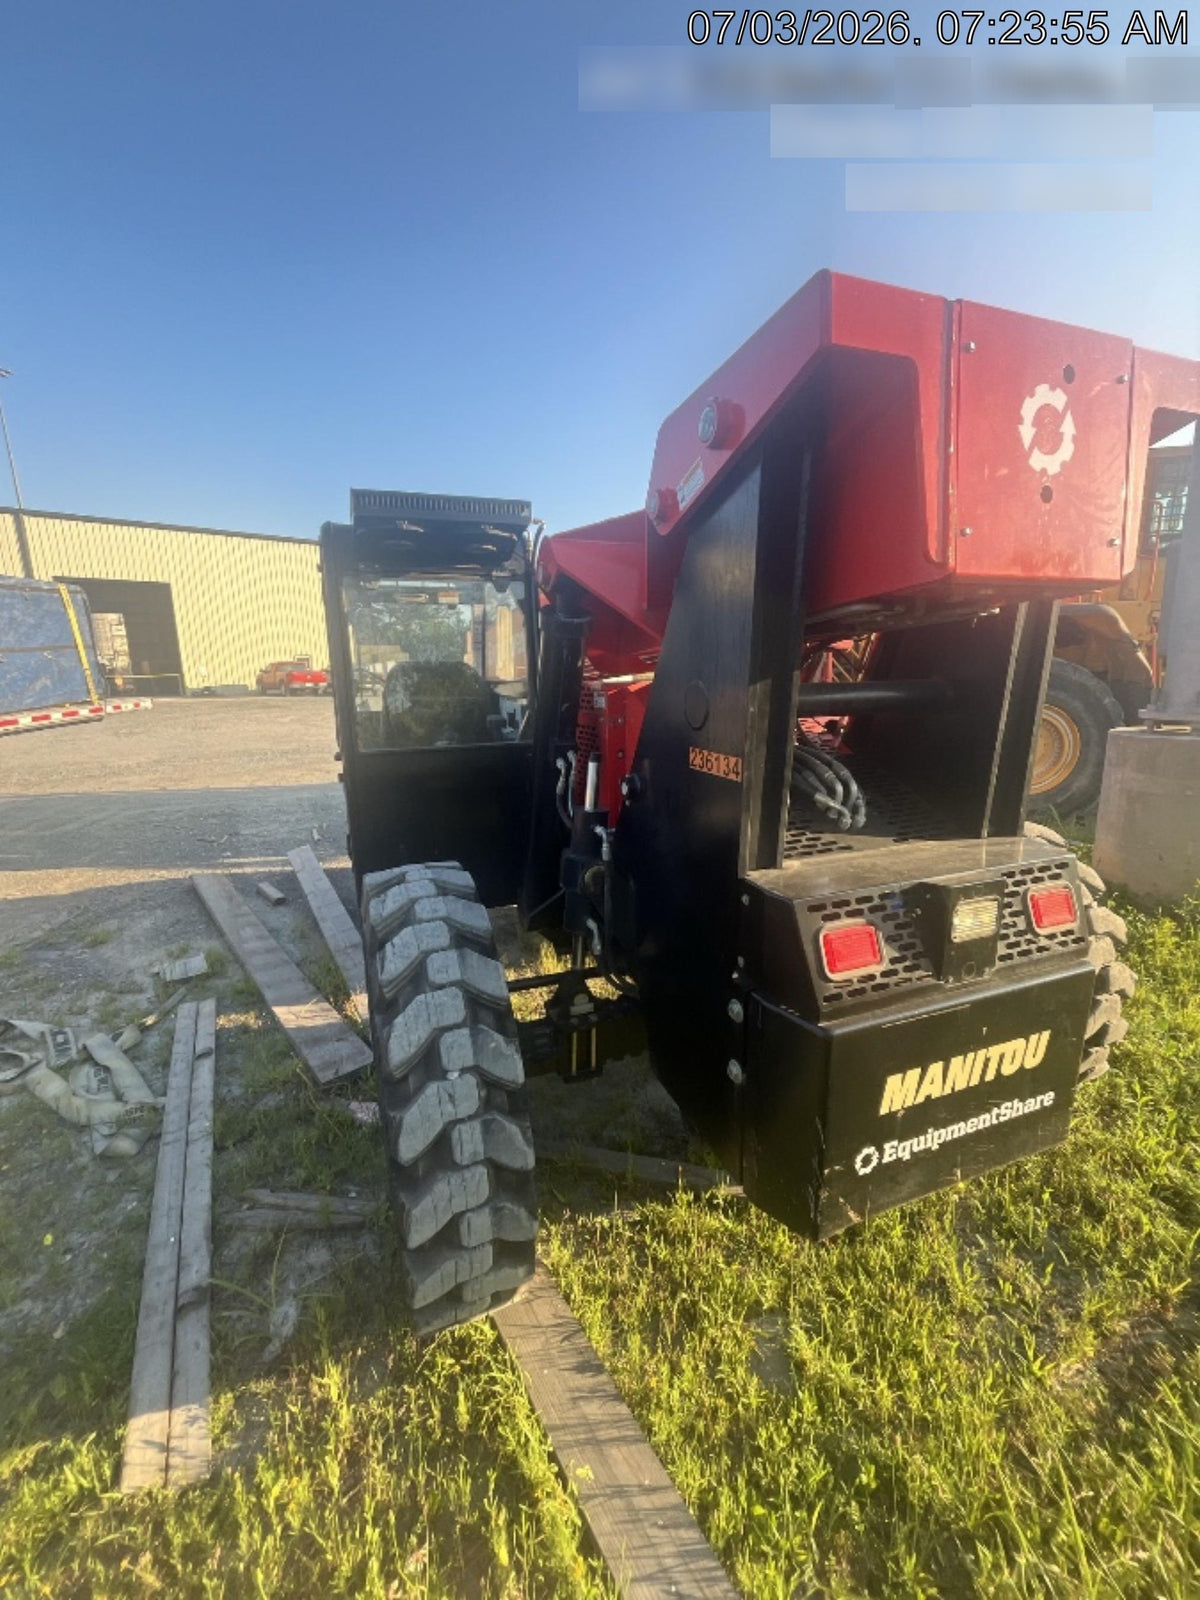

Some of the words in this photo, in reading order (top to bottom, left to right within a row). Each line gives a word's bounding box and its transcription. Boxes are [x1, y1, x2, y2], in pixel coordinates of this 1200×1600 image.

[690, 747, 740, 780] 236134
[879, 1029, 1051, 1117] MANITOU
[881, 1091, 1055, 1164] EquipmentShare
